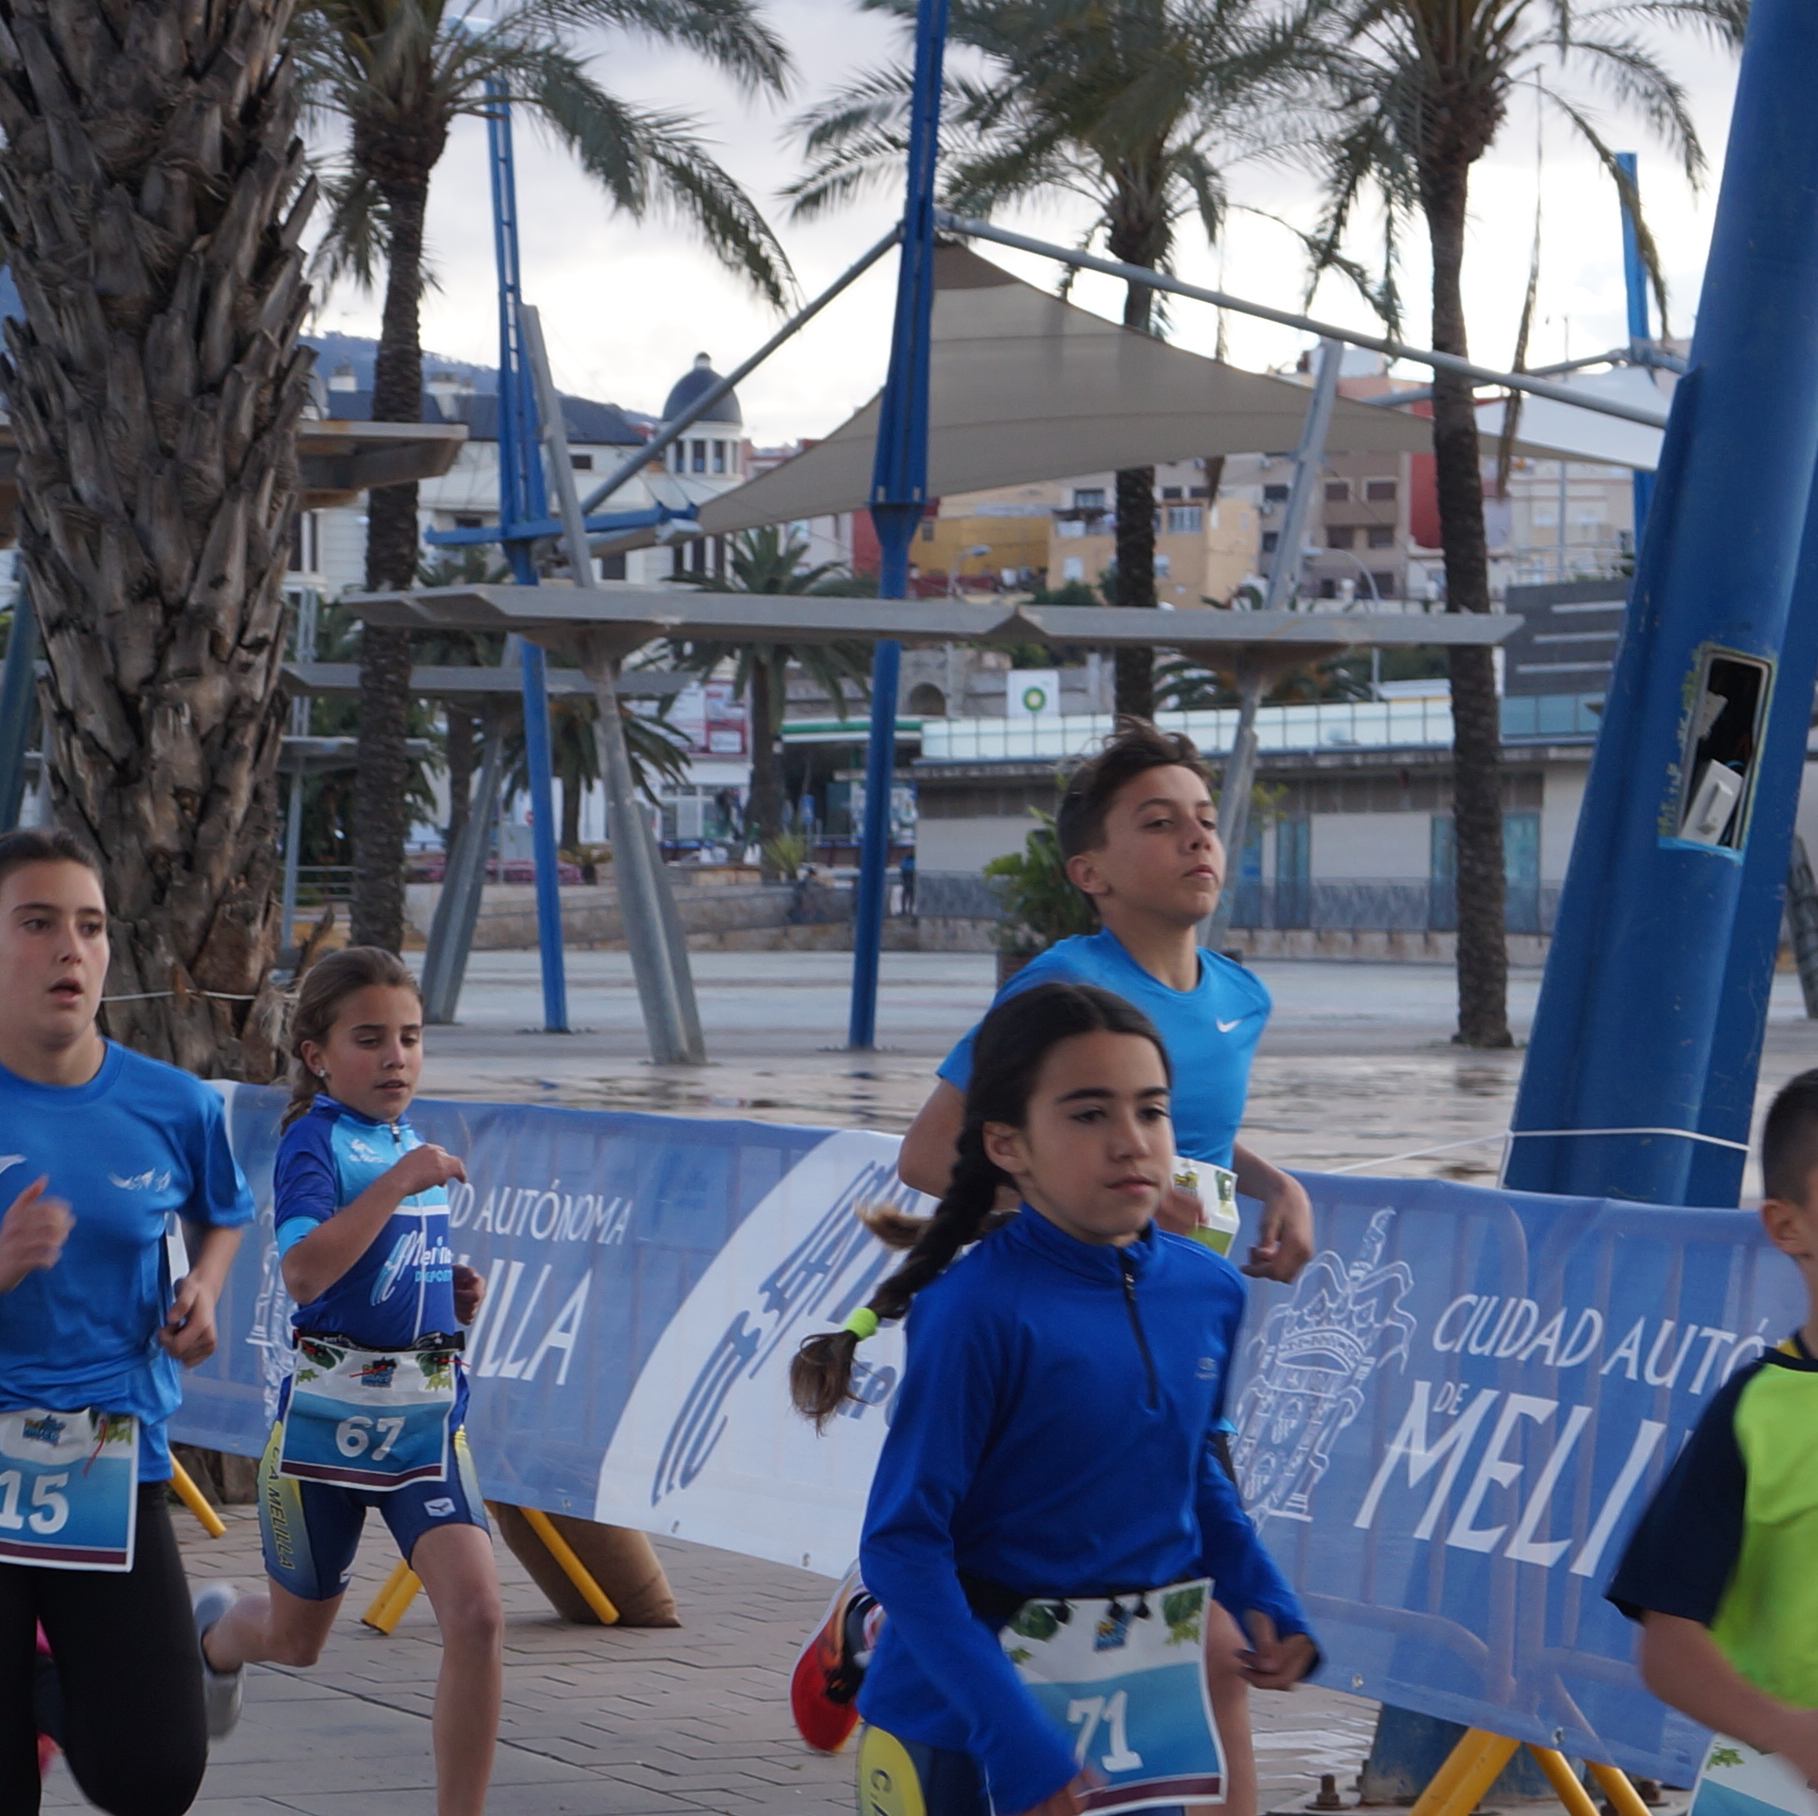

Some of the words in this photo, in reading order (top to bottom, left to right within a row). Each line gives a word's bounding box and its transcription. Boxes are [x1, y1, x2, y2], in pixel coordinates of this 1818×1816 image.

[472, 1178, 633, 1245] AUTÓNOMA
[1432, 1294, 1604, 1369] CIUDAD
[1432, 1381, 1470, 1415] DE
[336, 1416, 406, 1461] 67
[1353, 1380, 1689, 1578] MELI
[1067, 1690, 1144, 1773] 71
